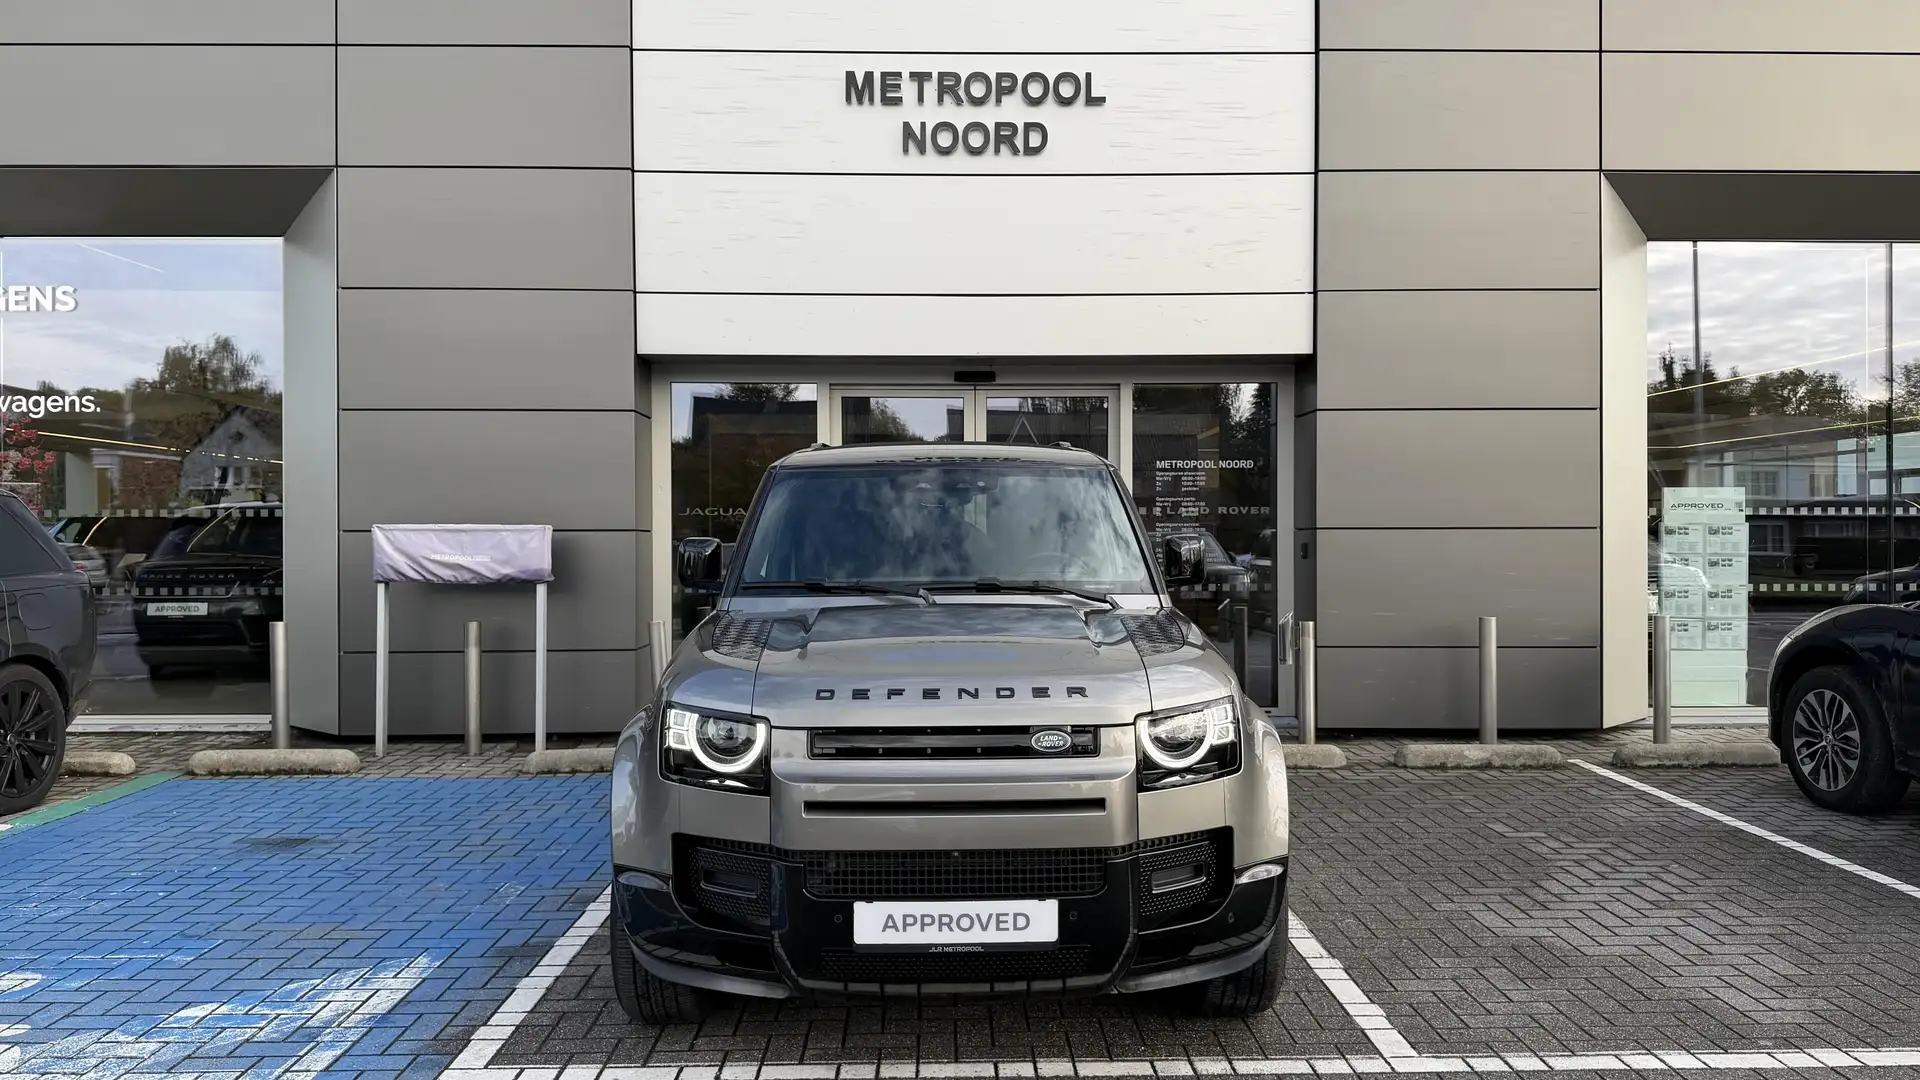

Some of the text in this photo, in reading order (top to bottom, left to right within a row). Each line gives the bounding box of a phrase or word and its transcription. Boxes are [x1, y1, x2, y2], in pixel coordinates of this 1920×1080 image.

[845, 70, 1107, 106] METROPOOL
[902, 121, 1048, 155] NOORD
[1156, 460, 1254, 469] METROPOOL NOORD
[679, 508, 748, 516] JAGUA
[1218, 506, 1270, 515] ROVER
[154, 605, 200, 613] APPROVED
[815, 686, 1088, 700] DEFENDER
[881, 912, 1031, 933] APPROVED
